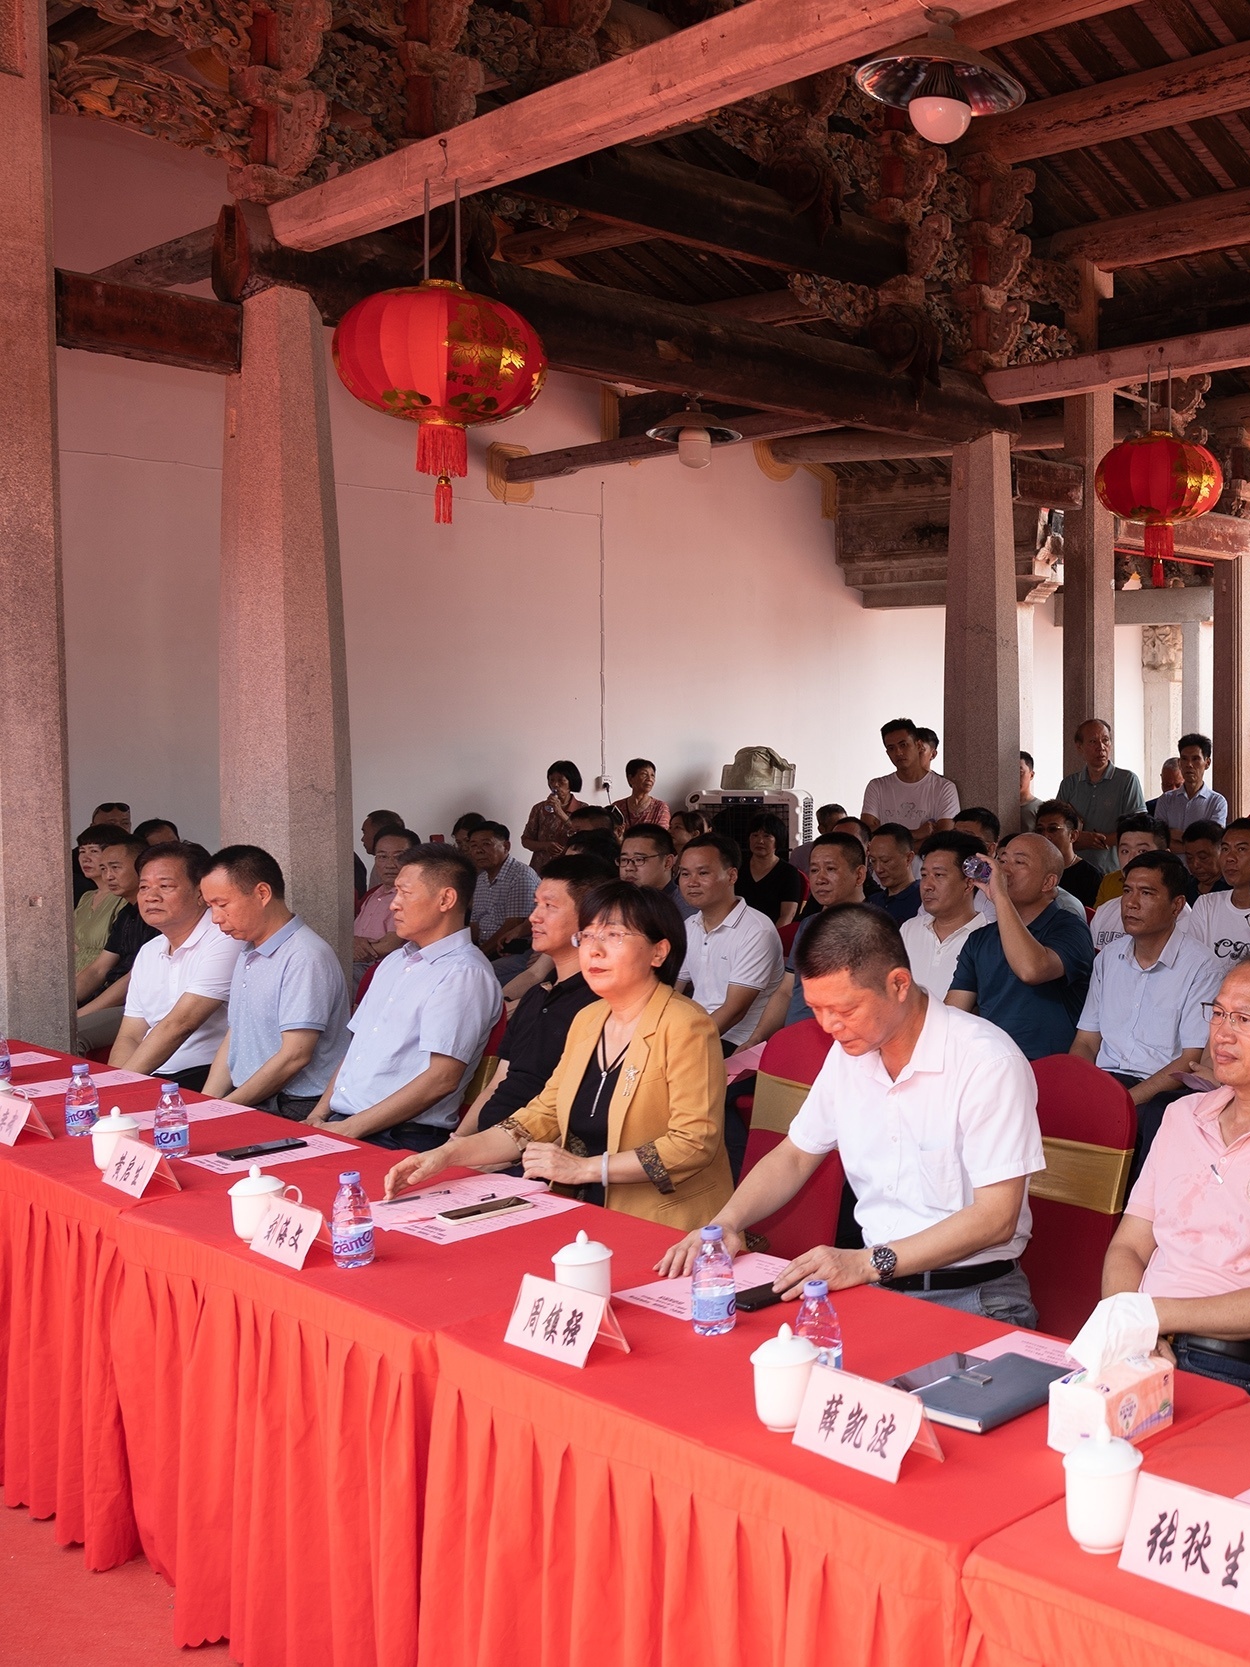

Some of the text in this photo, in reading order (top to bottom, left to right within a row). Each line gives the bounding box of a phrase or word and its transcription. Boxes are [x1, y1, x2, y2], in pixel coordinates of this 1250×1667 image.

[523, 1297, 584, 1347] 周镇强
[817, 1393, 896, 1459] 薛凯波
